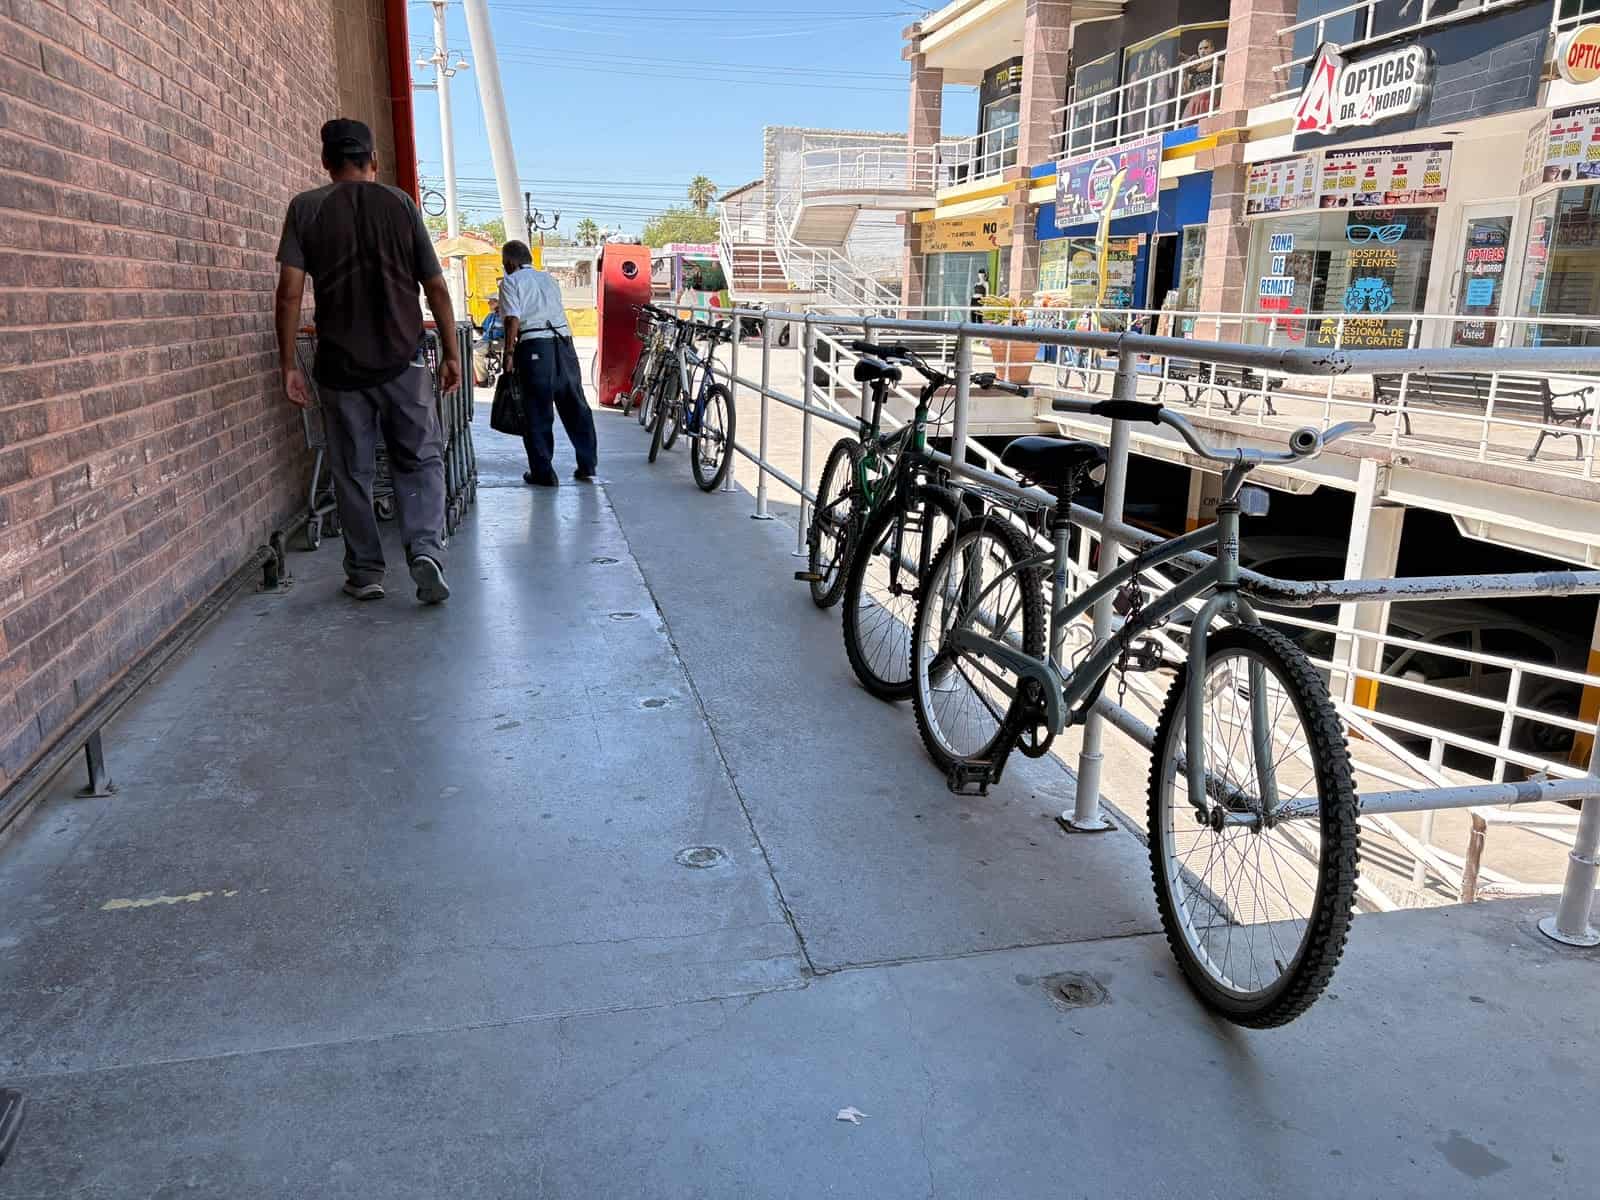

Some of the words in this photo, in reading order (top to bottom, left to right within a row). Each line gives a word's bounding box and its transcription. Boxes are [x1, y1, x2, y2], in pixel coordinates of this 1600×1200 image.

[1344, 53, 1416, 97] OPTICAS
[1340, 102, 1357, 120] DR.
[982, 222, 997, 234] NO
[1270, 235, 1293, 251] ZONA
[1348, 249, 1398, 259] HOSPITAL
[1466, 247, 1506, 261] OPTICAS
[1273, 257, 1285, 274] DE
[1345, 259, 1359, 267] DE
[1361, 259, 1398, 267] LENTES
[1261, 278, 1294, 294] REMATE
[1343, 319, 1384, 327] EXAMEN
[1390, 329, 1405, 337] DE
[1462, 329, 1485, 339] Usted
[1318, 335, 1331, 344] LA
[1365, 337, 1405, 346] GRATIS
